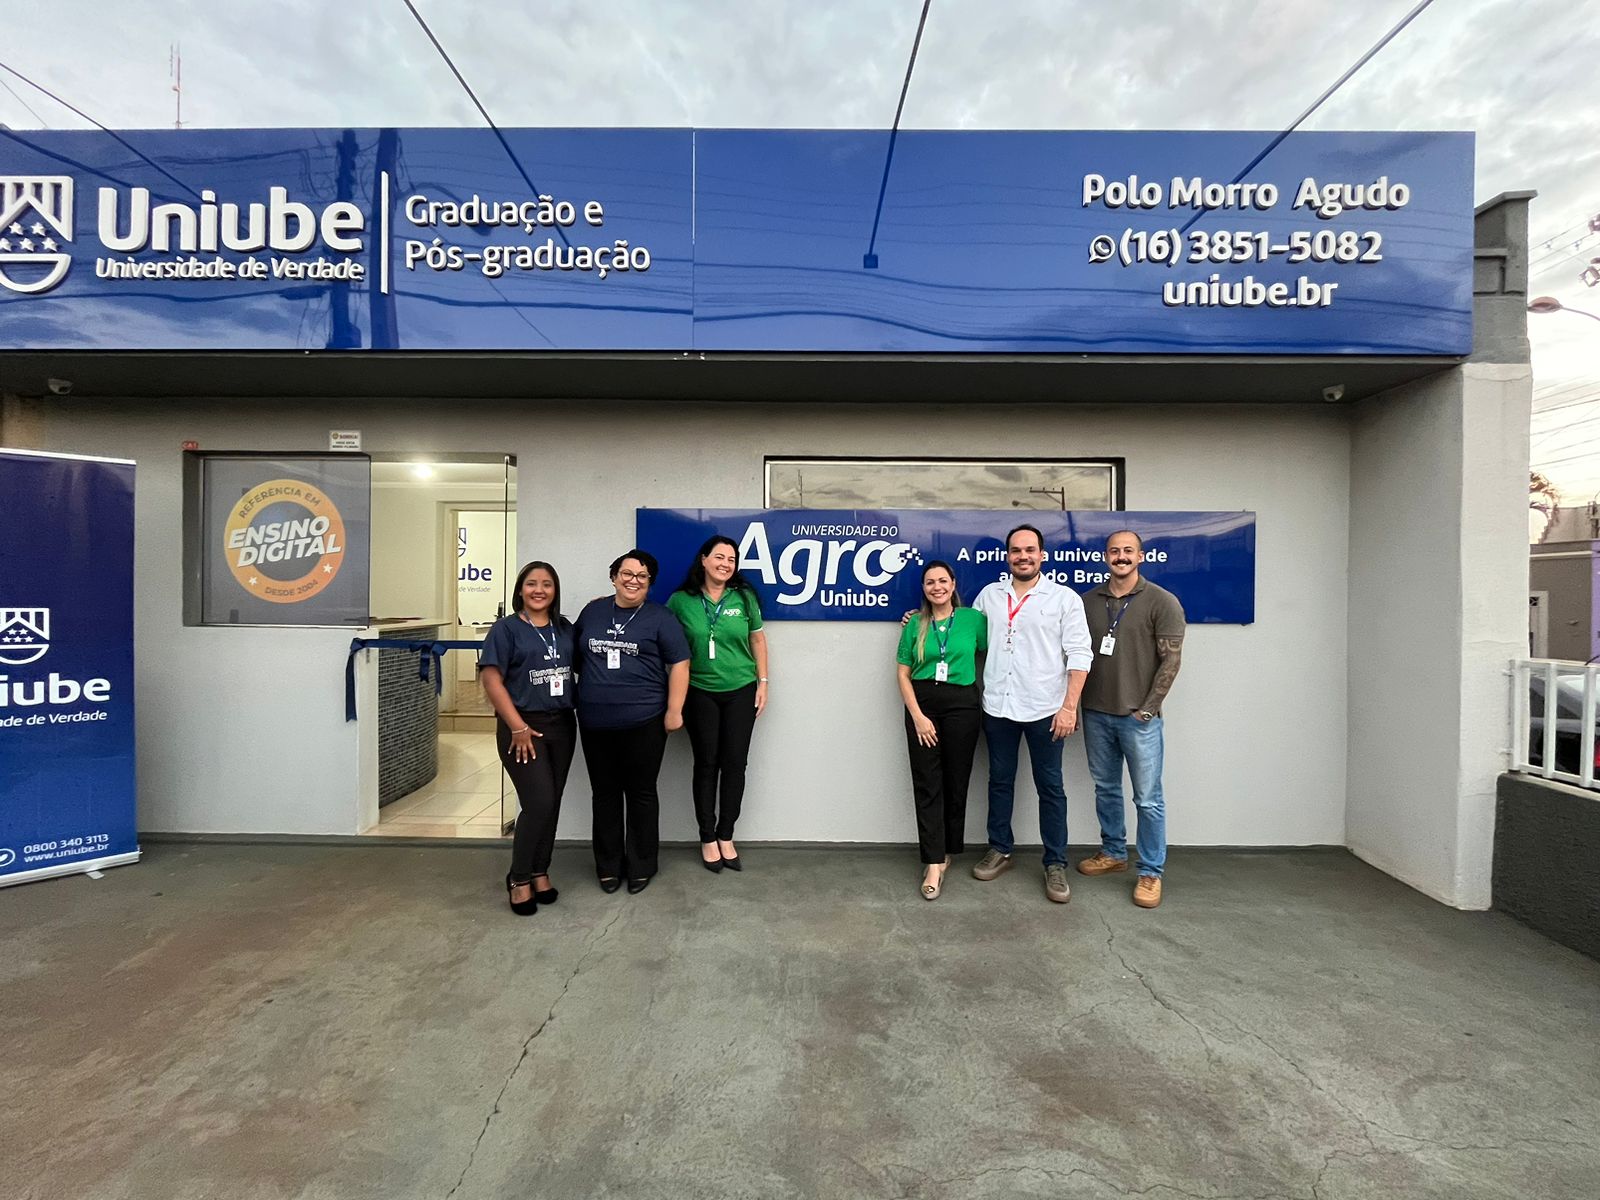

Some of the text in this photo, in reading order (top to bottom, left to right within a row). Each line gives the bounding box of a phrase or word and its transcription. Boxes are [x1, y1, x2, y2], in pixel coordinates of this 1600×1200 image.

[1082, 173, 1411, 218] Polo Morro Agudo
[98, 186, 364, 252] Uniube
[405, 194, 604, 234] Graduação e
[405, 237, 651, 279] Pós-graduação
[1119, 227, 1383, 266] (16) 3851-5082
[95, 256, 365, 280] Universidade de Verdade
[1162, 273, 1339, 307] uniube.br
[228, 515, 330, 549] ENSINO
[791, 524, 898, 537] UNIVERSIDADE DO
[237, 533, 342, 568] DIGITAL
[738, 521, 911, 606] Agro
[956, 546, 1168, 564] A pria univede
[458, 563, 492, 581] ube
[1046, 568, 1112, 584] do Bras
[820, 588, 889, 607] Uniube
[0, 672, 111, 707] iube
[26, 714, 46, 726] de
[48, 710, 108, 724] Verdade
[23, 833, 109, 854] 0800 340 3113
[24, 843, 110, 862] www.uniube.br
